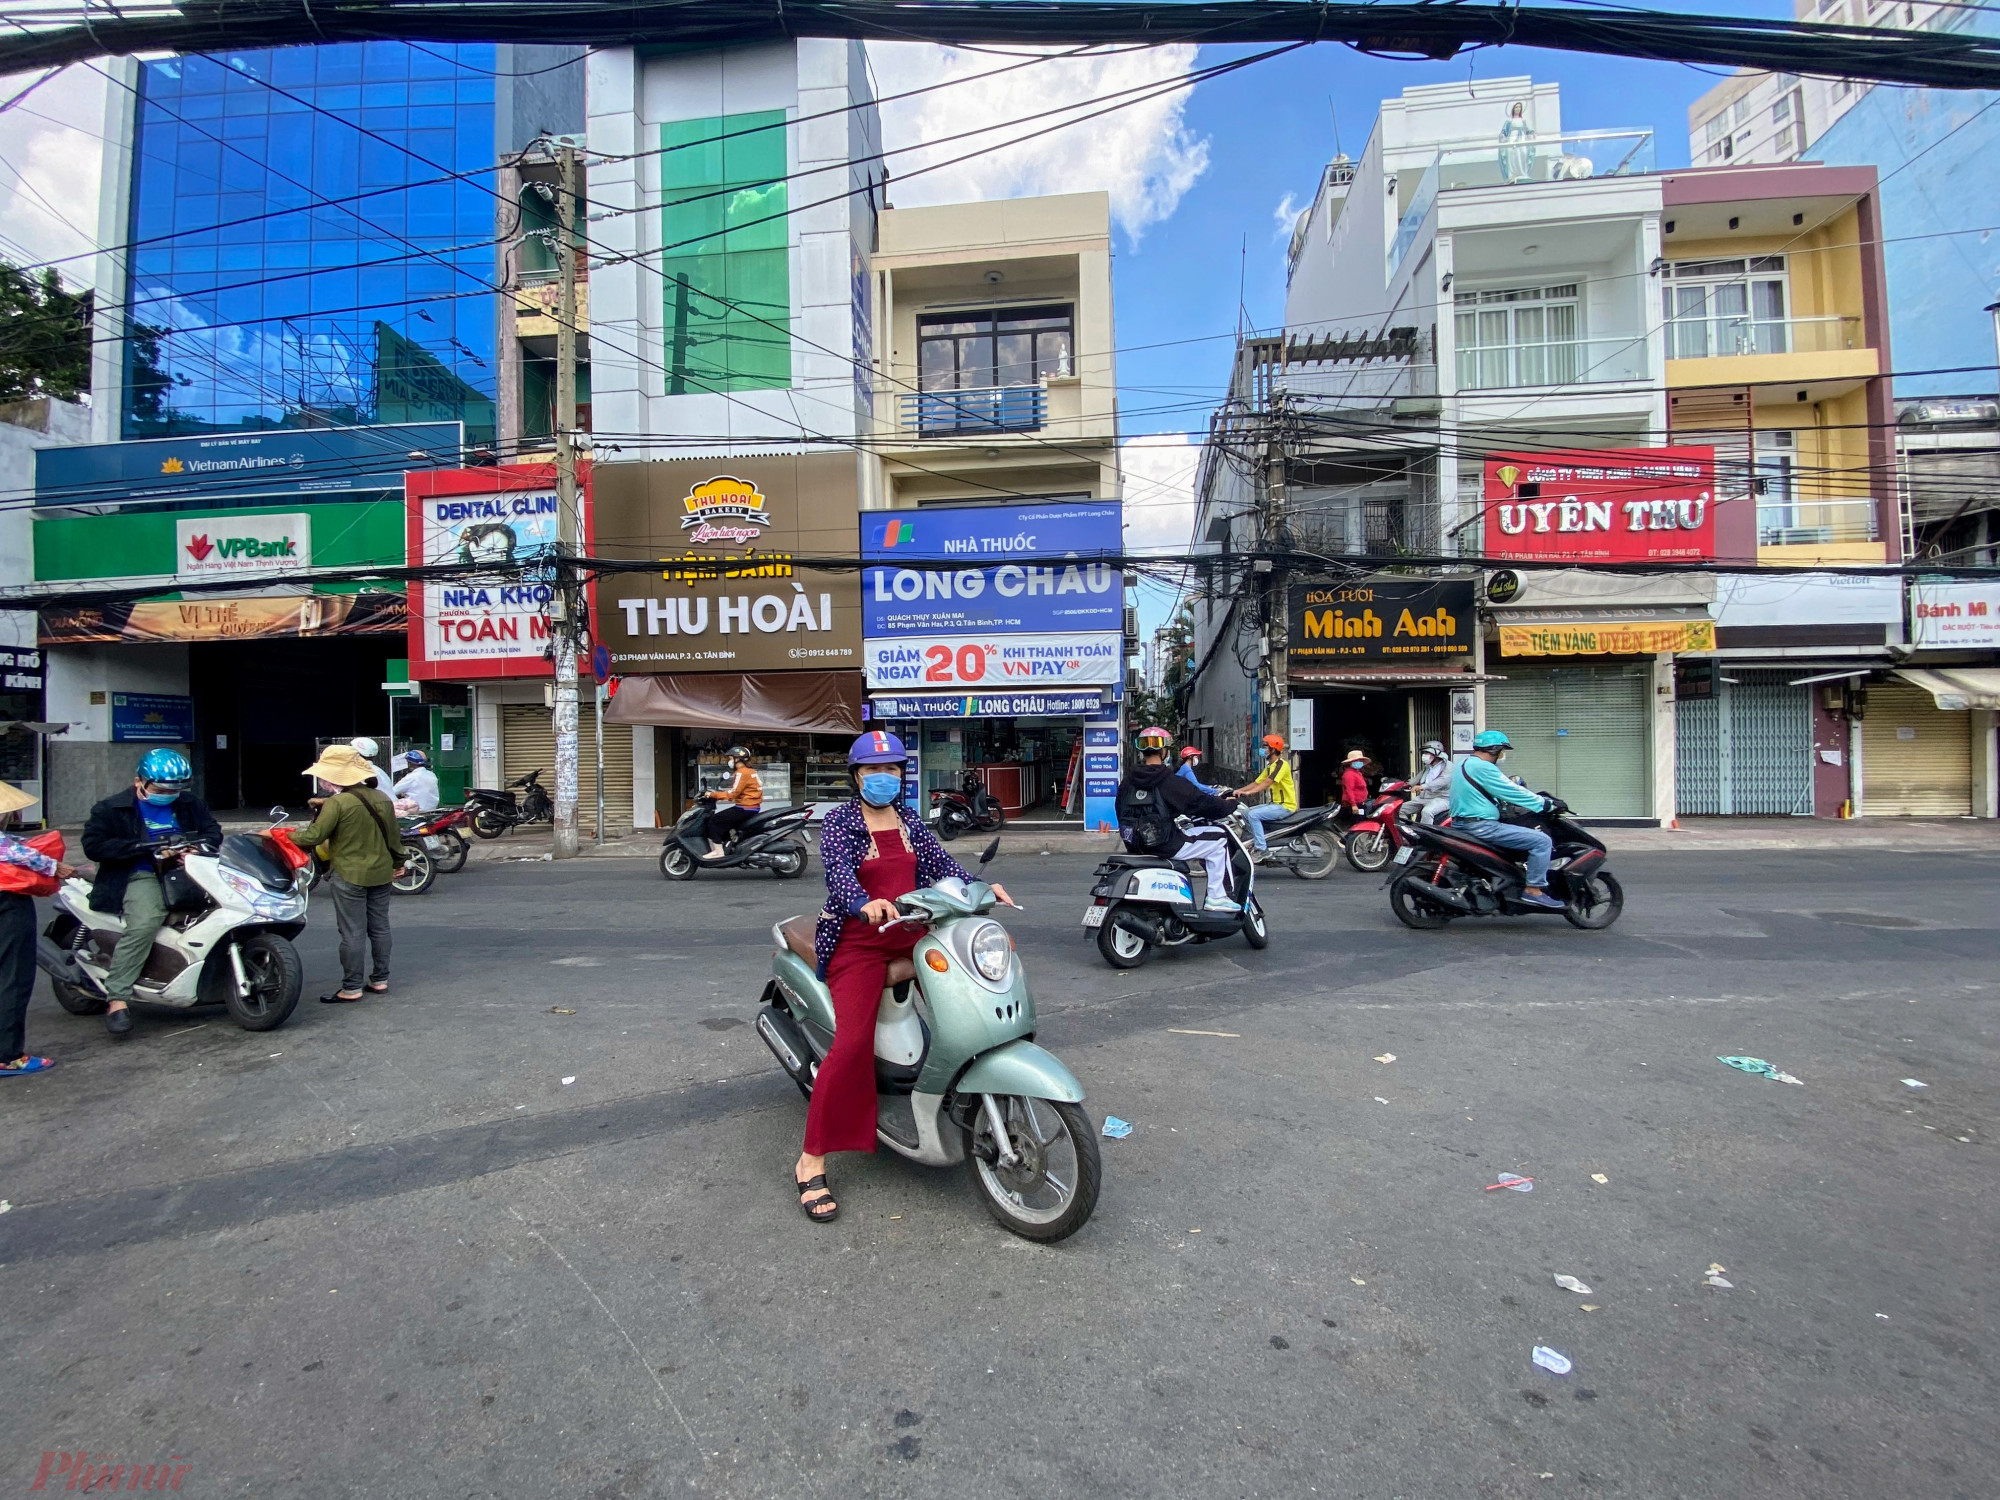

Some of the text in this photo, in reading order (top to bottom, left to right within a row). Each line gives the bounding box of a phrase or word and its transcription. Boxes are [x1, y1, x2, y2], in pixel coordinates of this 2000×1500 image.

[188, 456, 286, 472] Vietnam Airlines
[1526, 466, 1557, 482] CÔNG
[1558, 468, 1572, 481] TY
[437, 495, 557, 521] DENTAL CLINI
[692, 492, 751, 508] THU HOÀI
[704, 506, 743, 515] BAKERY
[1498, 491, 1710, 535] UYÊN THƯ
[690, 523, 719, 543] Luôn
[216, 535, 297, 559] VPBank
[944, 532, 1036, 554] NHÀ THUỐC
[186, 559, 298, 571] Ngân Hàng Việt Nam Thịnh Vượng
[874, 552, 1111, 602] LONG CHÂU
[443, 585, 552, 607] NHA KHO
[178, 605, 200, 630] VỊ
[205, 602, 239, 623] THẾ
[374, 604, 408, 615] DIAM
[440, 609, 470, 617] PHƯƠNG
[618, 582, 832, 636] THU HOÀI
[887, 613, 912, 622] QUÁCH
[932, 612, 951, 620] XUÂN
[1916, 603, 1961, 618] Bánh
[438, 609, 552, 643] TOÀN M
[916, 620, 930, 628] Văn
[1005, 618, 1021, 626] HCM
[1304, 607, 1456, 639] Minh Anh
[1530, 628, 1561, 652] TIỆM
[1564, 628, 1596, 651] VÀNG
[1599, 625, 1645, 652] UYÊN
[1648, 626, 1687, 652] THƯ
[627, 653, 648, 662] PHẠM
[649, 651, 665, 660] VĂN
[703, 650, 718, 659] TÂN
[719, 650, 736, 659] BÌNH
[878, 645, 920, 663] GIẢM
[1003, 643, 1112, 658] KHI THANH TOÁN
[5, 672, 42, 689] KÍNH
[877, 665, 922, 680] NGAY
[899, 701, 921, 713] NHÀ
[923, 699, 960, 712] THUỐC
[978, 699, 1010, 714] LONG
[1012, 696, 1045, 714] CHÂU
[1046, 699, 1070, 711] Hotline:
[1071, 698, 1085, 710] 1800
[1086, 698, 1100, 710] 6928
